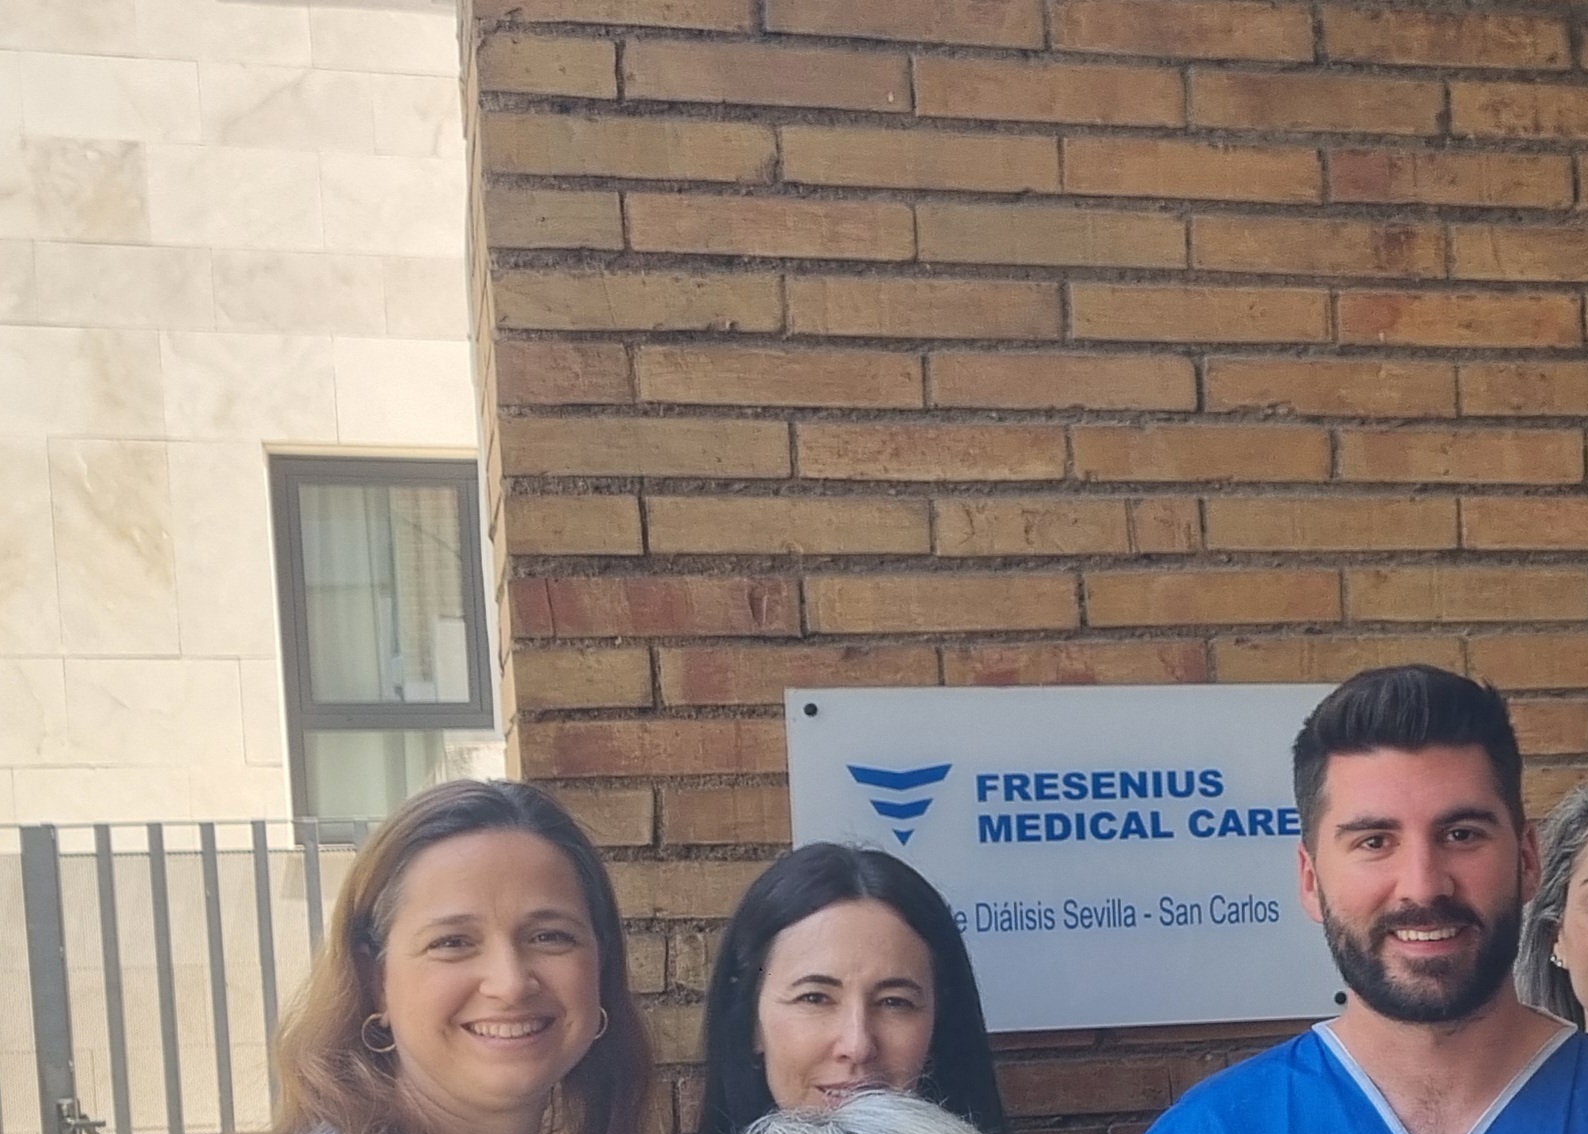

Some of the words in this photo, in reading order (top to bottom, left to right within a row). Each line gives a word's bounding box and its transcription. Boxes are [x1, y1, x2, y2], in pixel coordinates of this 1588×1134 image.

[976, 770, 1223, 801] FRESENIUS
[978, 812, 1174, 842] MEDICAL
[1188, 808, 1301, 837] CARE
[975, 901, 1055, 932] Diálisis
[1063, 898, 1137, 929] Sevilla
[1159, 896, 1202, 926] San
[1210, 894, 1280, 923] Carlos
